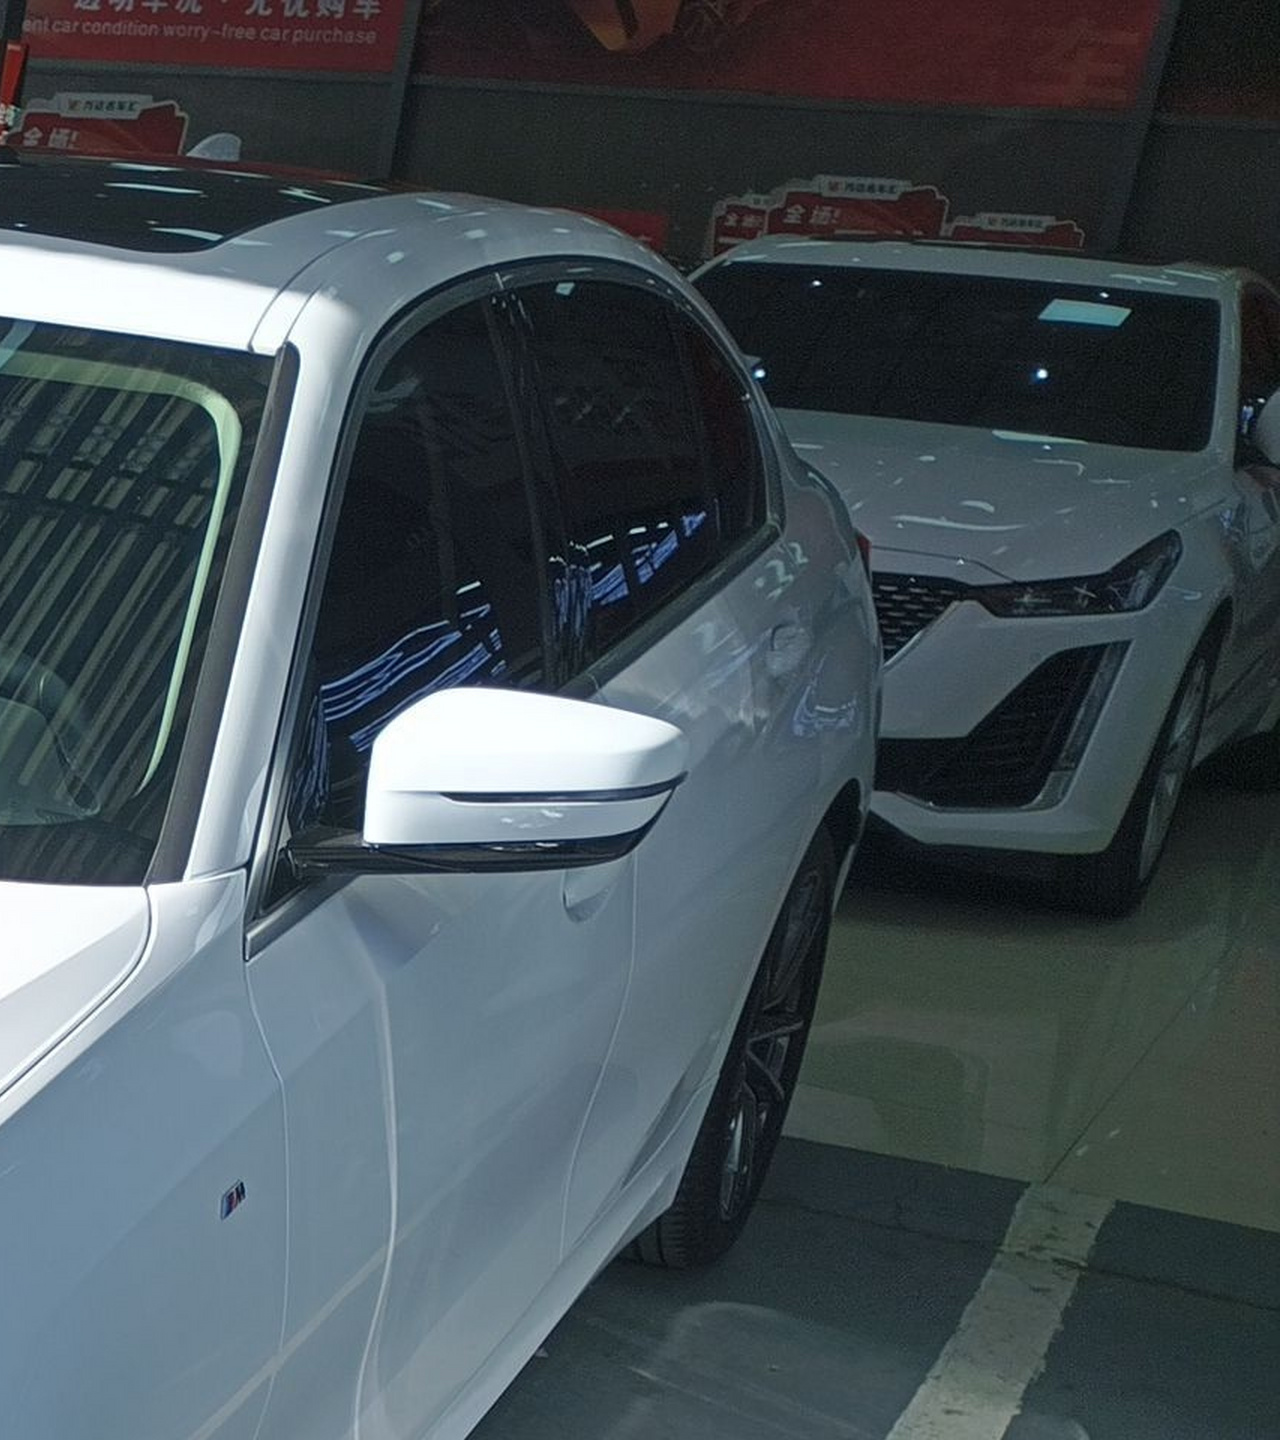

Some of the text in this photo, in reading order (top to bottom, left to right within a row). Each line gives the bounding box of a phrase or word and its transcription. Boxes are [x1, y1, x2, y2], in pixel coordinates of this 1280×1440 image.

[52, 19, 79, 34] car
[82, 20, 160, 38] condition
[162, 23, 256, 43] worry-free
[260, 27, 290, 42] car
[292, 27, 377, 45] purchase
